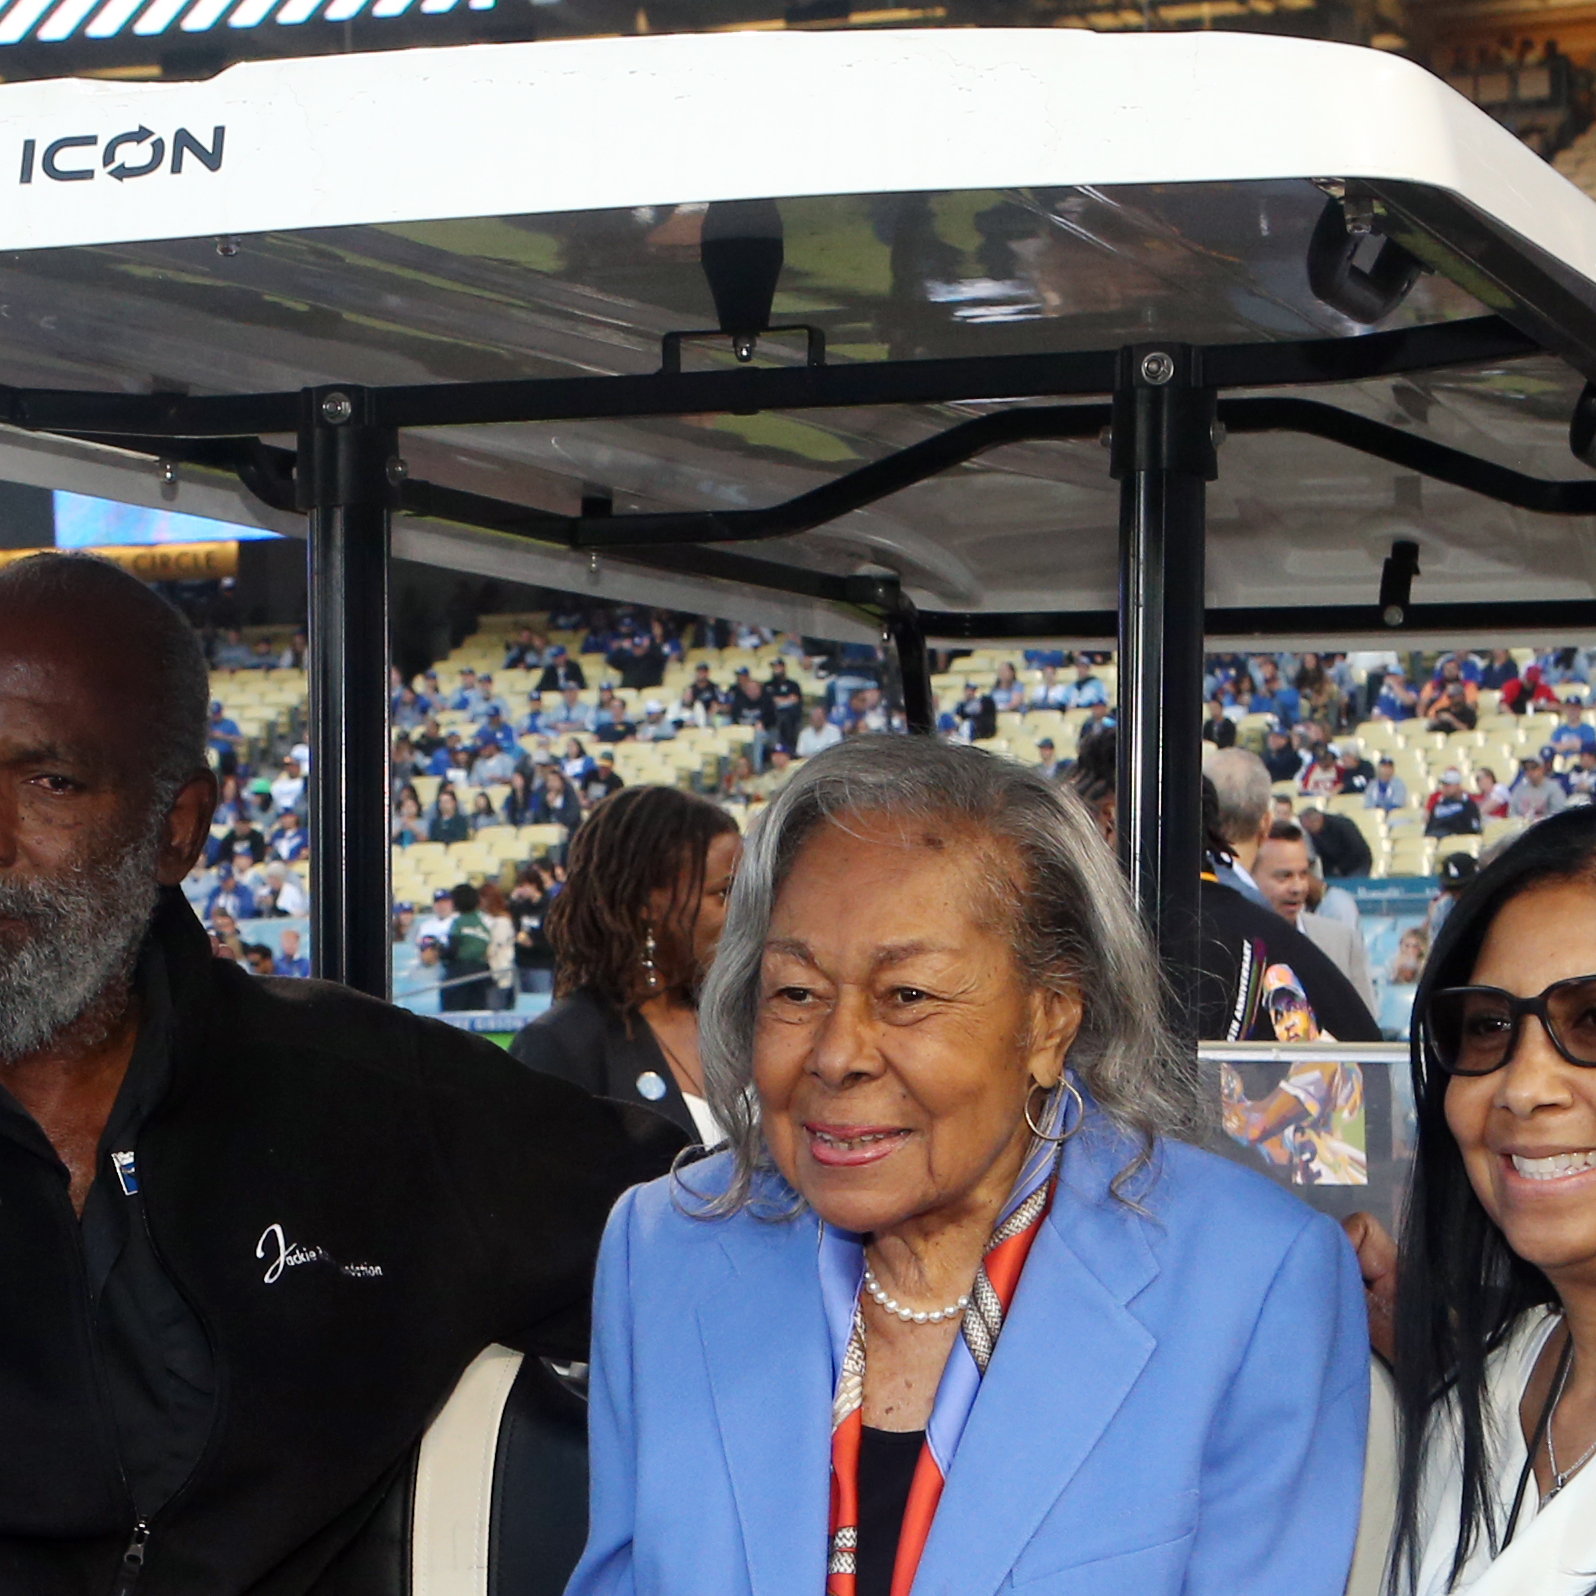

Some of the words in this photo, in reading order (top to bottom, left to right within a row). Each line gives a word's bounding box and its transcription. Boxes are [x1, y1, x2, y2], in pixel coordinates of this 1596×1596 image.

[19, 124, 226, 185] ICON
[132, 550, 223, 575] CIRCLE
[1234, 939, 1253, 1021] ANNIVERSARY
